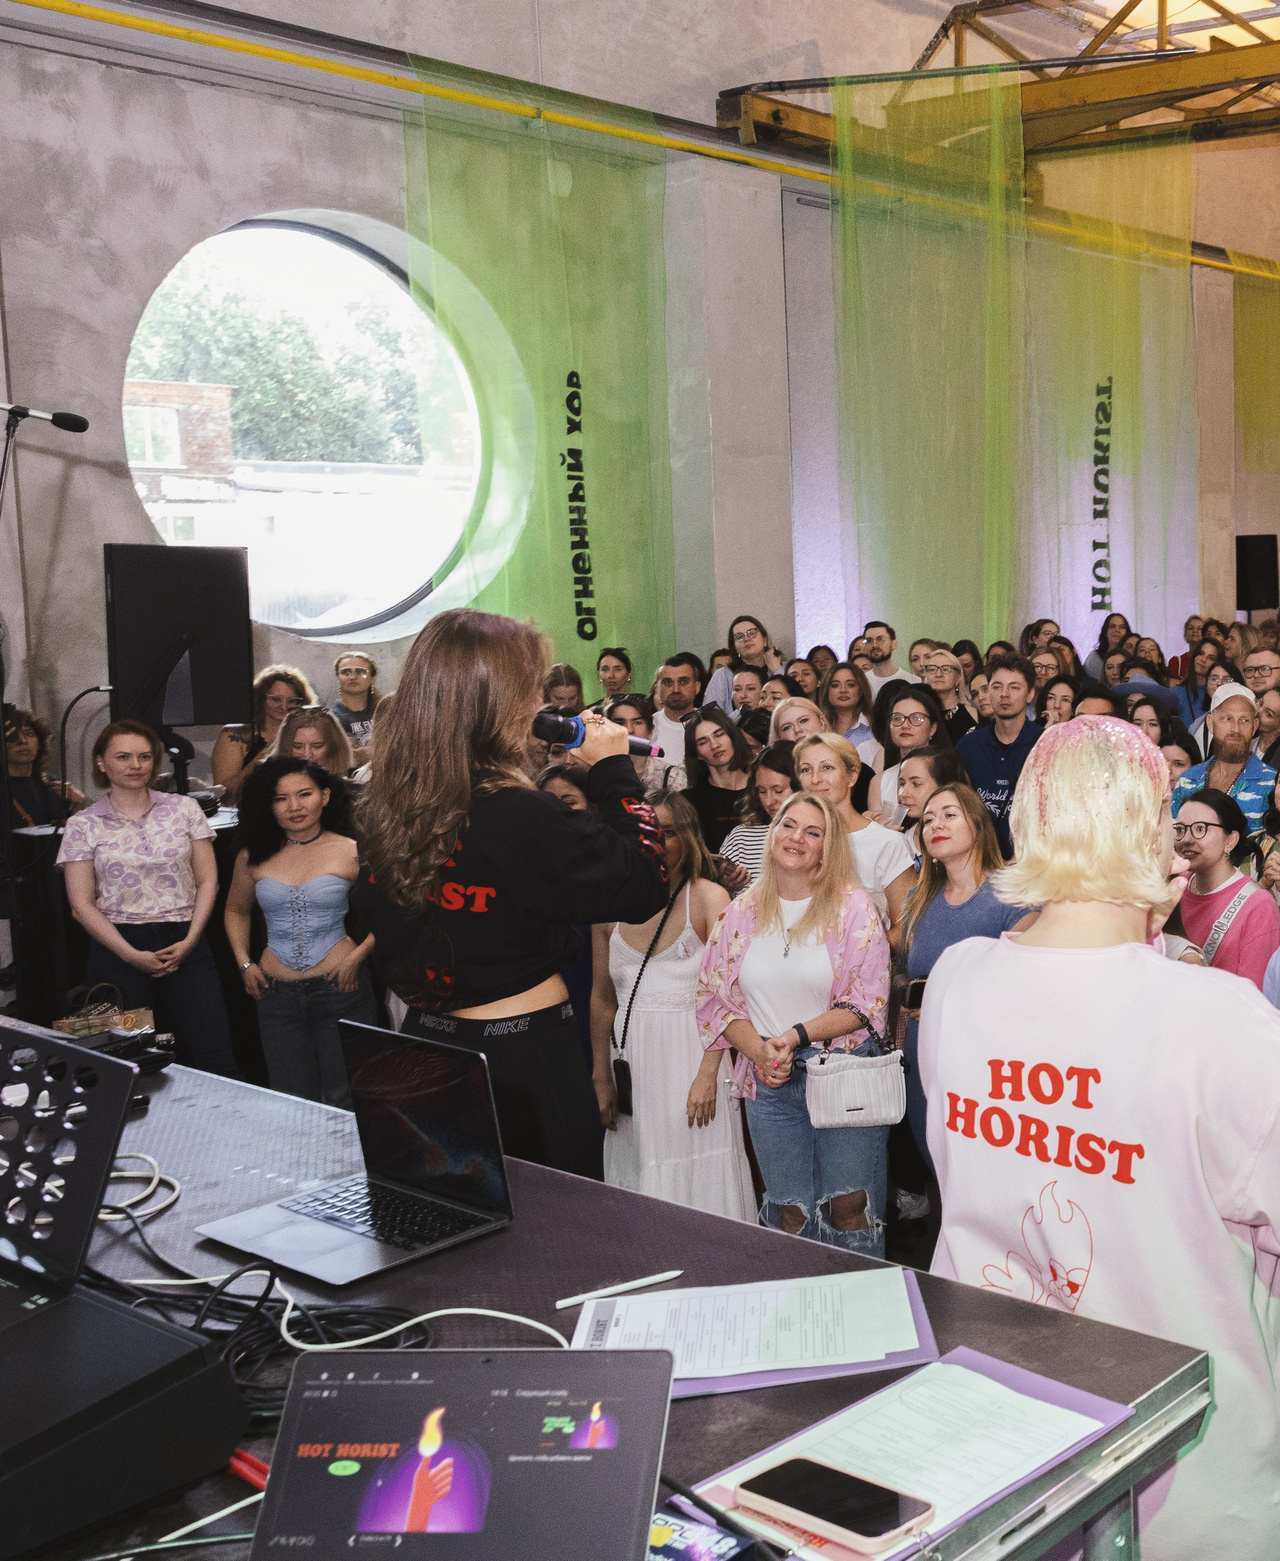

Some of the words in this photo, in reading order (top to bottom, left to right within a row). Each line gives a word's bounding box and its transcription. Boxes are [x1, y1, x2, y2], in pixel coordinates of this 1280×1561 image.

[1203, 893, 1248, 956] KNOEDGE
[483, 1016, 531, 1037] NIKE
[987, 1058, 1102, 1110] HOT
[945, 1091, 1145, 1185] HORIST
[296, 1443, 334, 1458] HOT
[335, 1443, 401, 1458] HORIST
